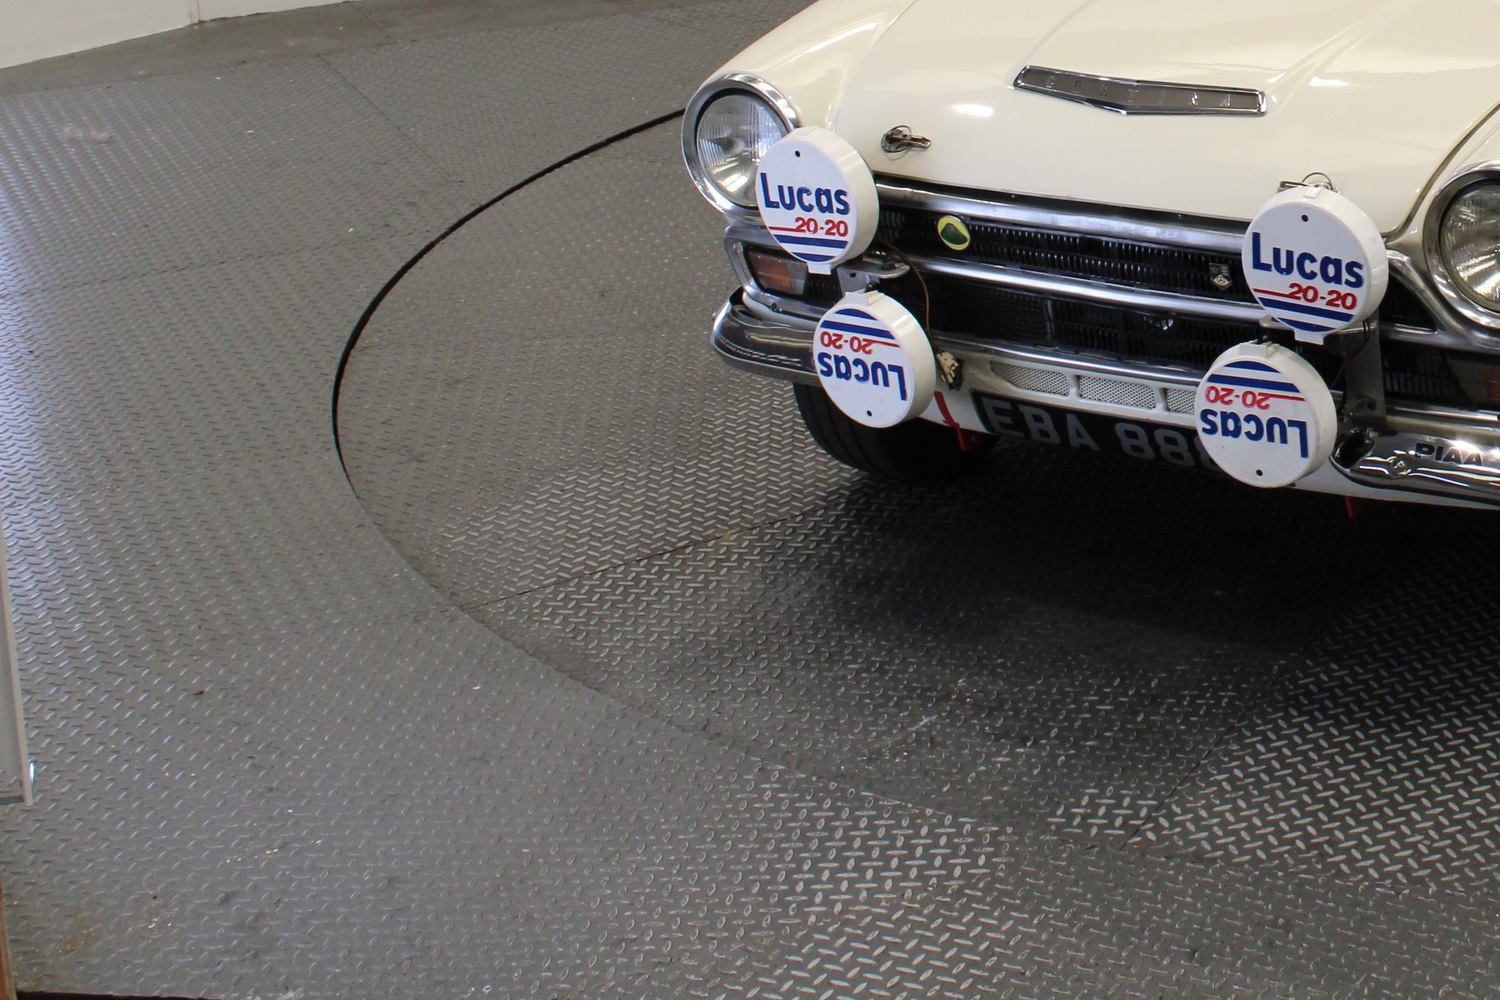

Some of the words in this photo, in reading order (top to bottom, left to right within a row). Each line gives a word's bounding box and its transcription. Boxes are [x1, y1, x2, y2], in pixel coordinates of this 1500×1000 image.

[759, 172, 850, 216] Lucas
[794, 216, 849, 238] 20-20
[1251, 231, 1364, 289] Lucas
[1287, 282, 1358, 311] 20-20
[820, 330, 874, 355] 20-20
[816, 351, 908, 402] Lucas
[1205, 385, 1271, 411] 20-20
[981, 396, 1100, 452] EBA
[1200, 408, 1309, 459] Lucas
